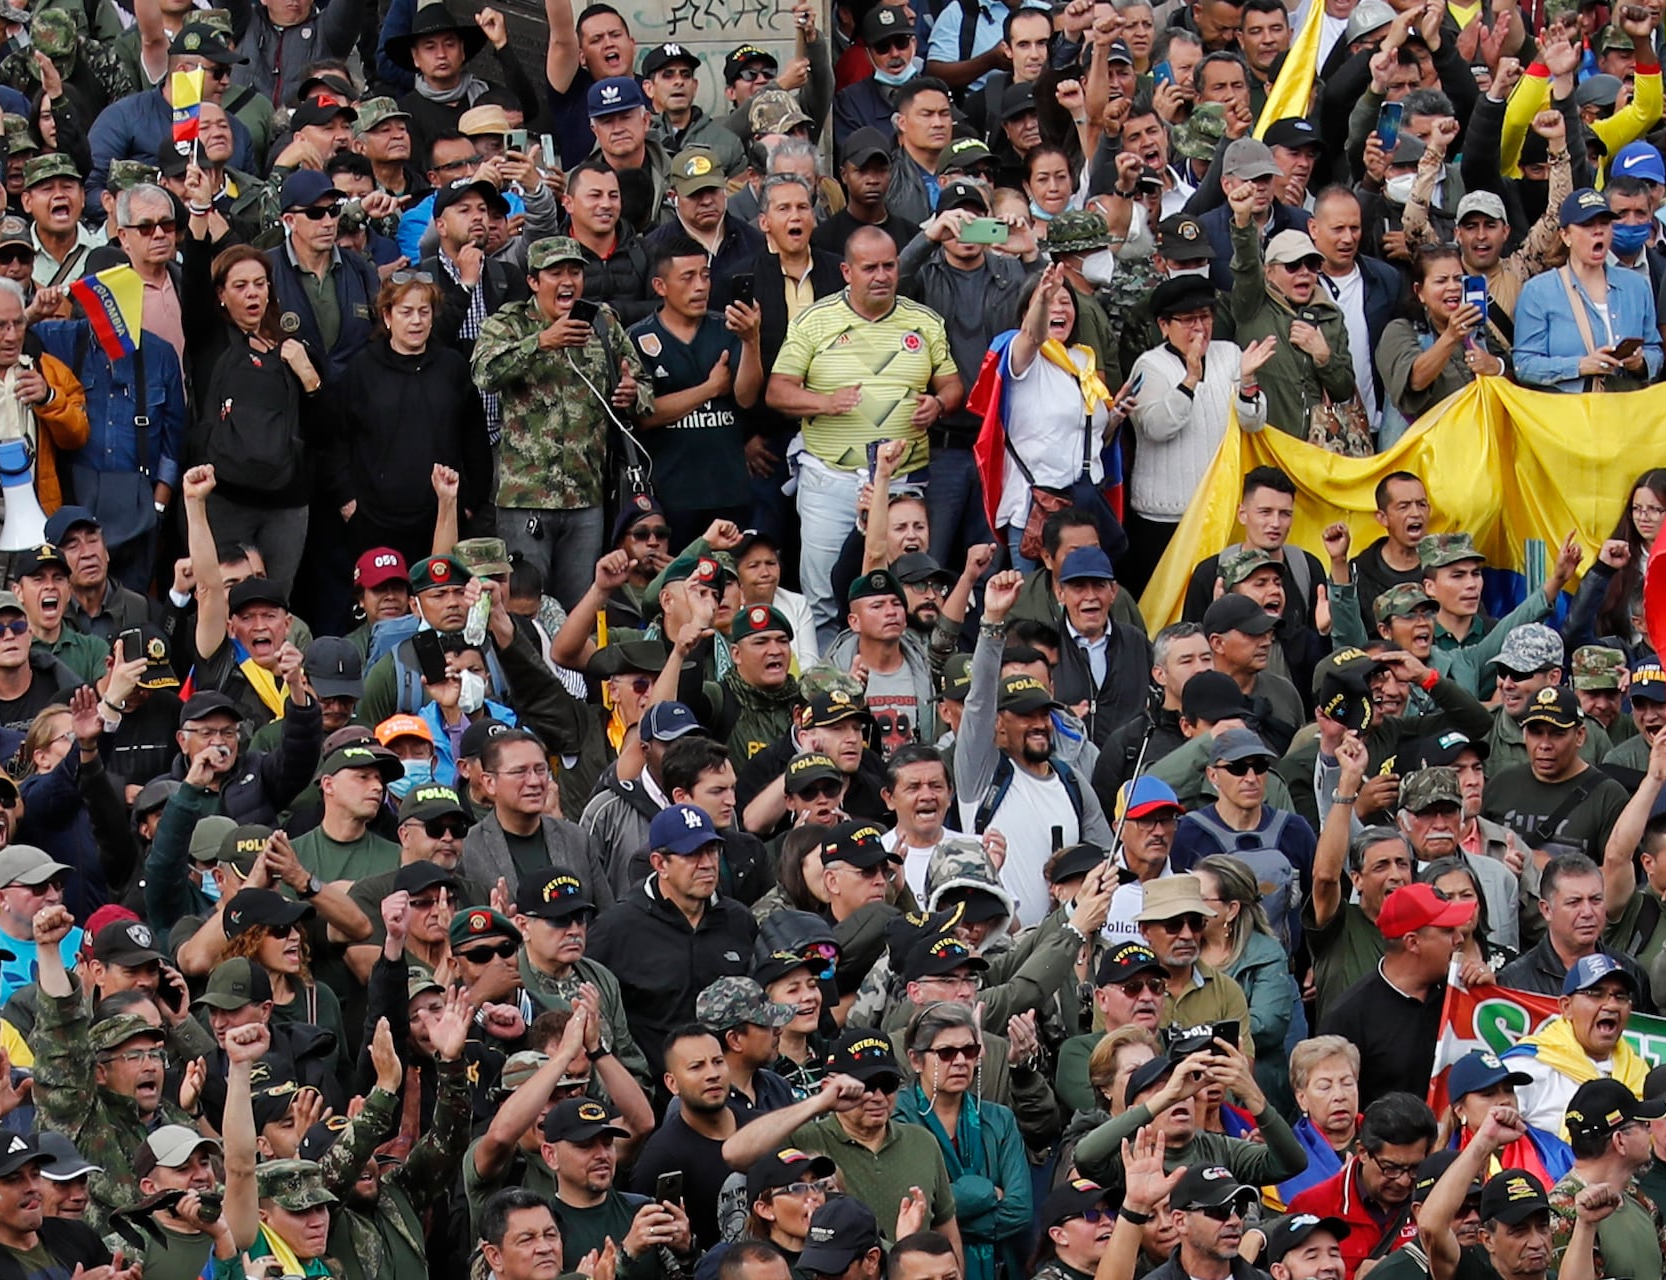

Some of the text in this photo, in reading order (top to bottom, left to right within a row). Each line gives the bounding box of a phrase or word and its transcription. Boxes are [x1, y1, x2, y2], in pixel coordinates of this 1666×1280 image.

[92, 286, 125, 337] COLOMBIA
[1334, 649, 1365, 664] POLI
[237, 838, 270, 853] POLI
[849, 1039, 889, 1054] VETERANO
